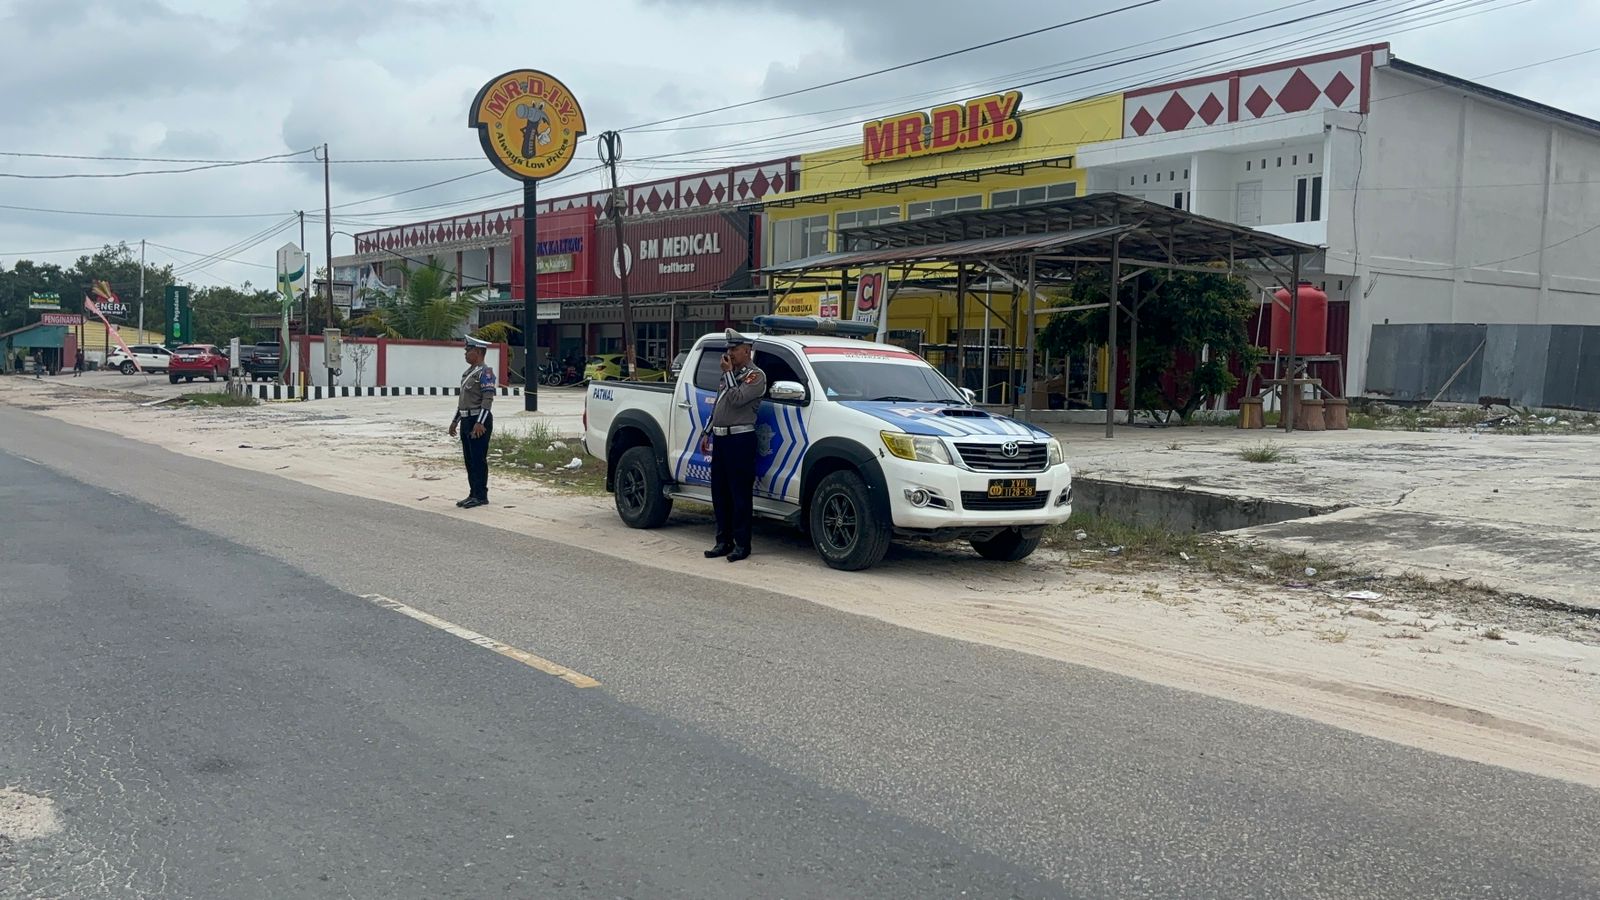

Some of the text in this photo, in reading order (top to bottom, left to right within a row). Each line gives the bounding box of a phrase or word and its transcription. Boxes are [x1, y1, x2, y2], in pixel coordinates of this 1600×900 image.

[496, 131, 524, 165] Always
[525, 161, 546, 169] Low
[546, 138, 569, 166] Prices
[639, 232, 721, 260] BM MEDICAL
[659, 262, 695, 274] Healthcare
[790, 303, 813, 313] DIBUKA
[44, 315, 81, 324] PENGINAPAN
[593, 388, 613, 401] PATWAL
